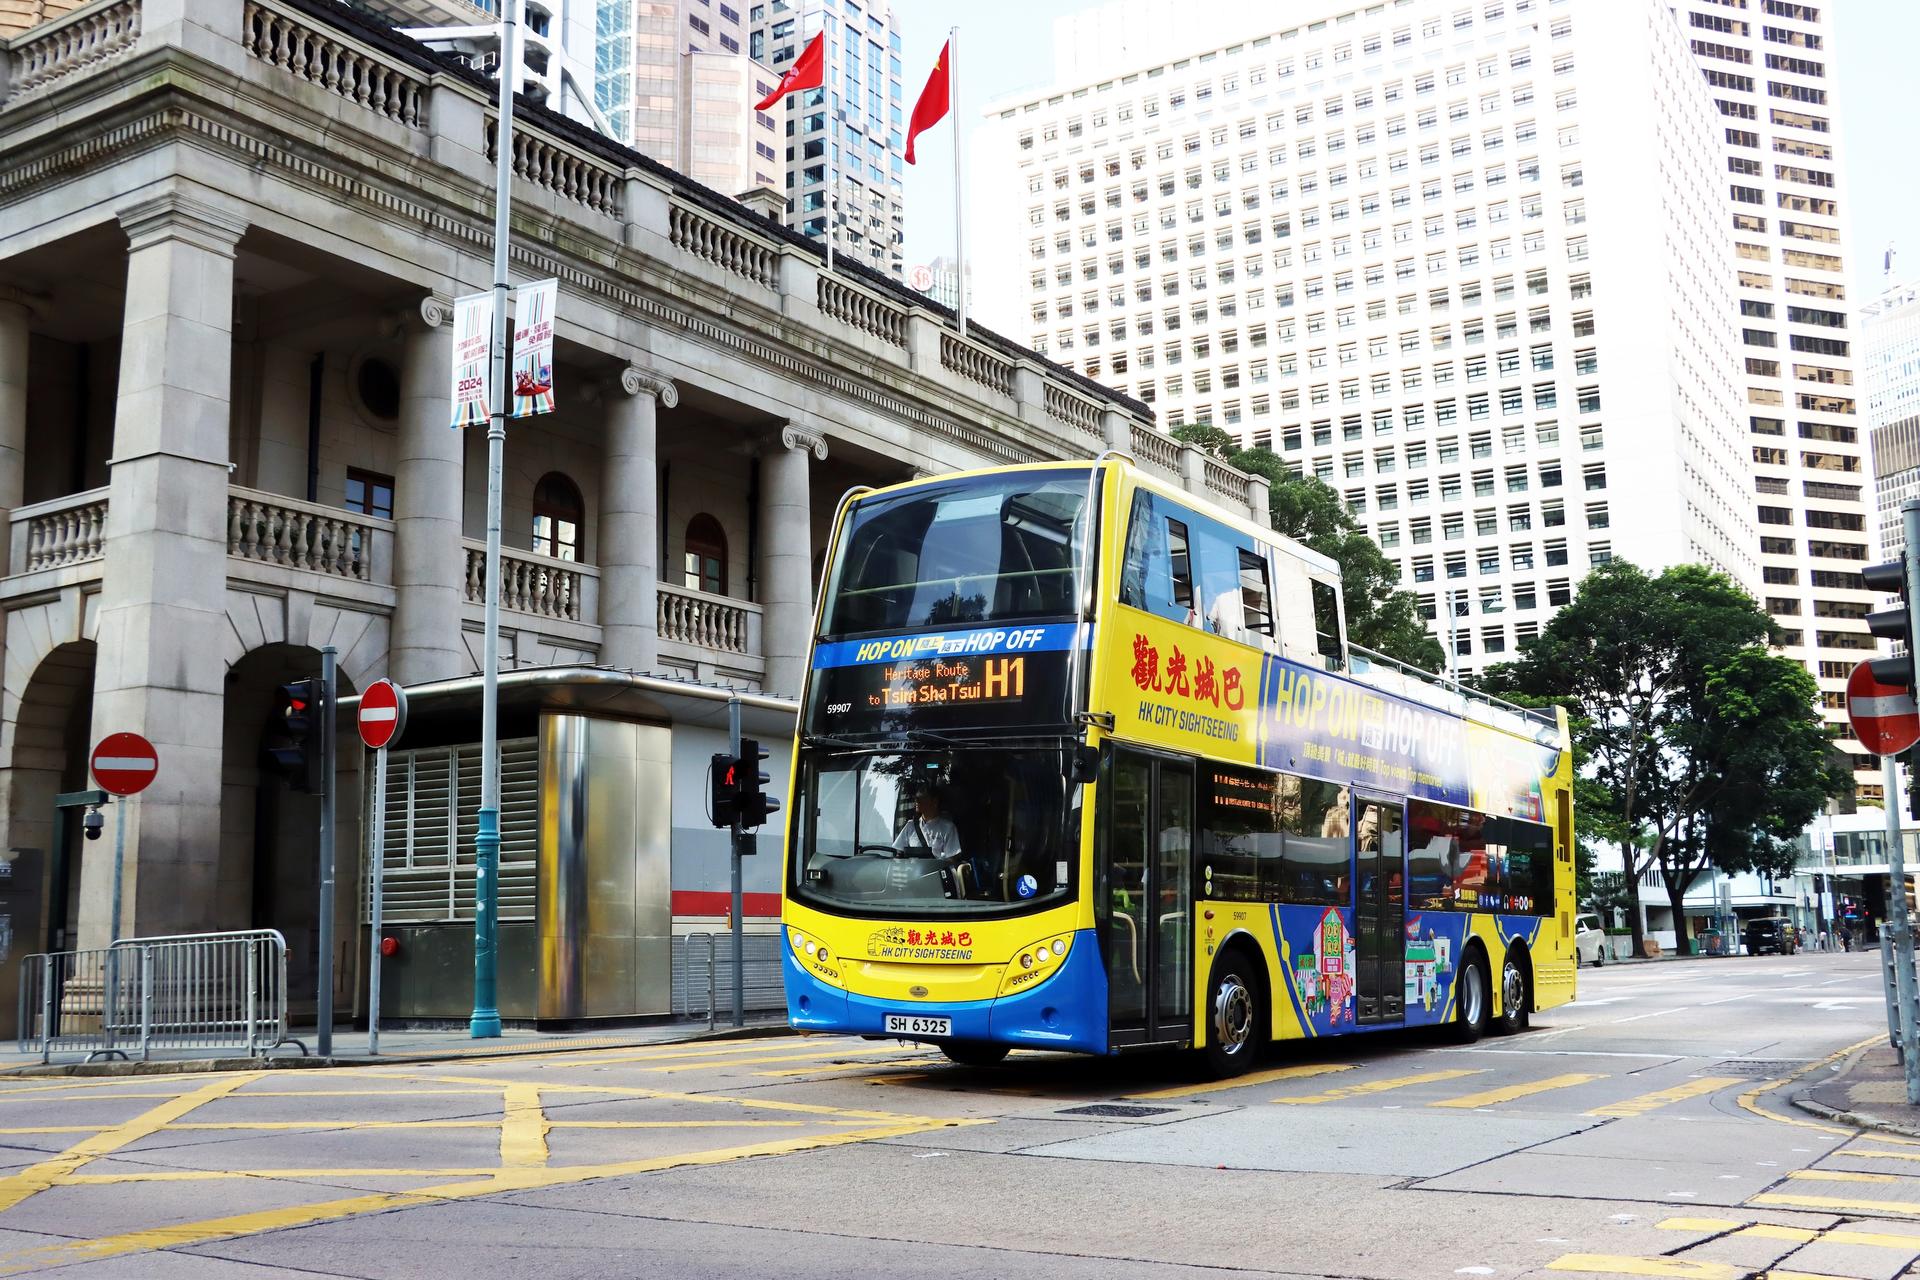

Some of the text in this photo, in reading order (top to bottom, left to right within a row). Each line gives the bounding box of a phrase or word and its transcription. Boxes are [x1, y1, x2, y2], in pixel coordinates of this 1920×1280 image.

[458, 377, 483, 392] 2024
[856, 641, 892, 662] HOP
[891, 638, 918, 658] ON
[965, 632, 1005, 652] HOP
[1007, 628, 1045, 650] OFF
[884, 657, 1024, 698] Heritage Route H1
[1131, 633, 1245, 711] 觀光城巴
[869, 682, 980, 706] to Tsim Sha Tsui
[827, 703, 851, 714] 59907
[1276, 668, 1327, 730] HOP
[1328, 685, 1360, 741] ON
[1384, 702, 1424, 757] HOP
[1427, 715, 1459, 766] OFF
[1138, 700, 1239, 742] HK CITY SIGHTSEEING
[907, 928, 973, 947] 觀光城巴
[881, 947, 973, 960] HK CITY SIGHTSEEING
[890, 1017, 947, 1033] SH 6325
